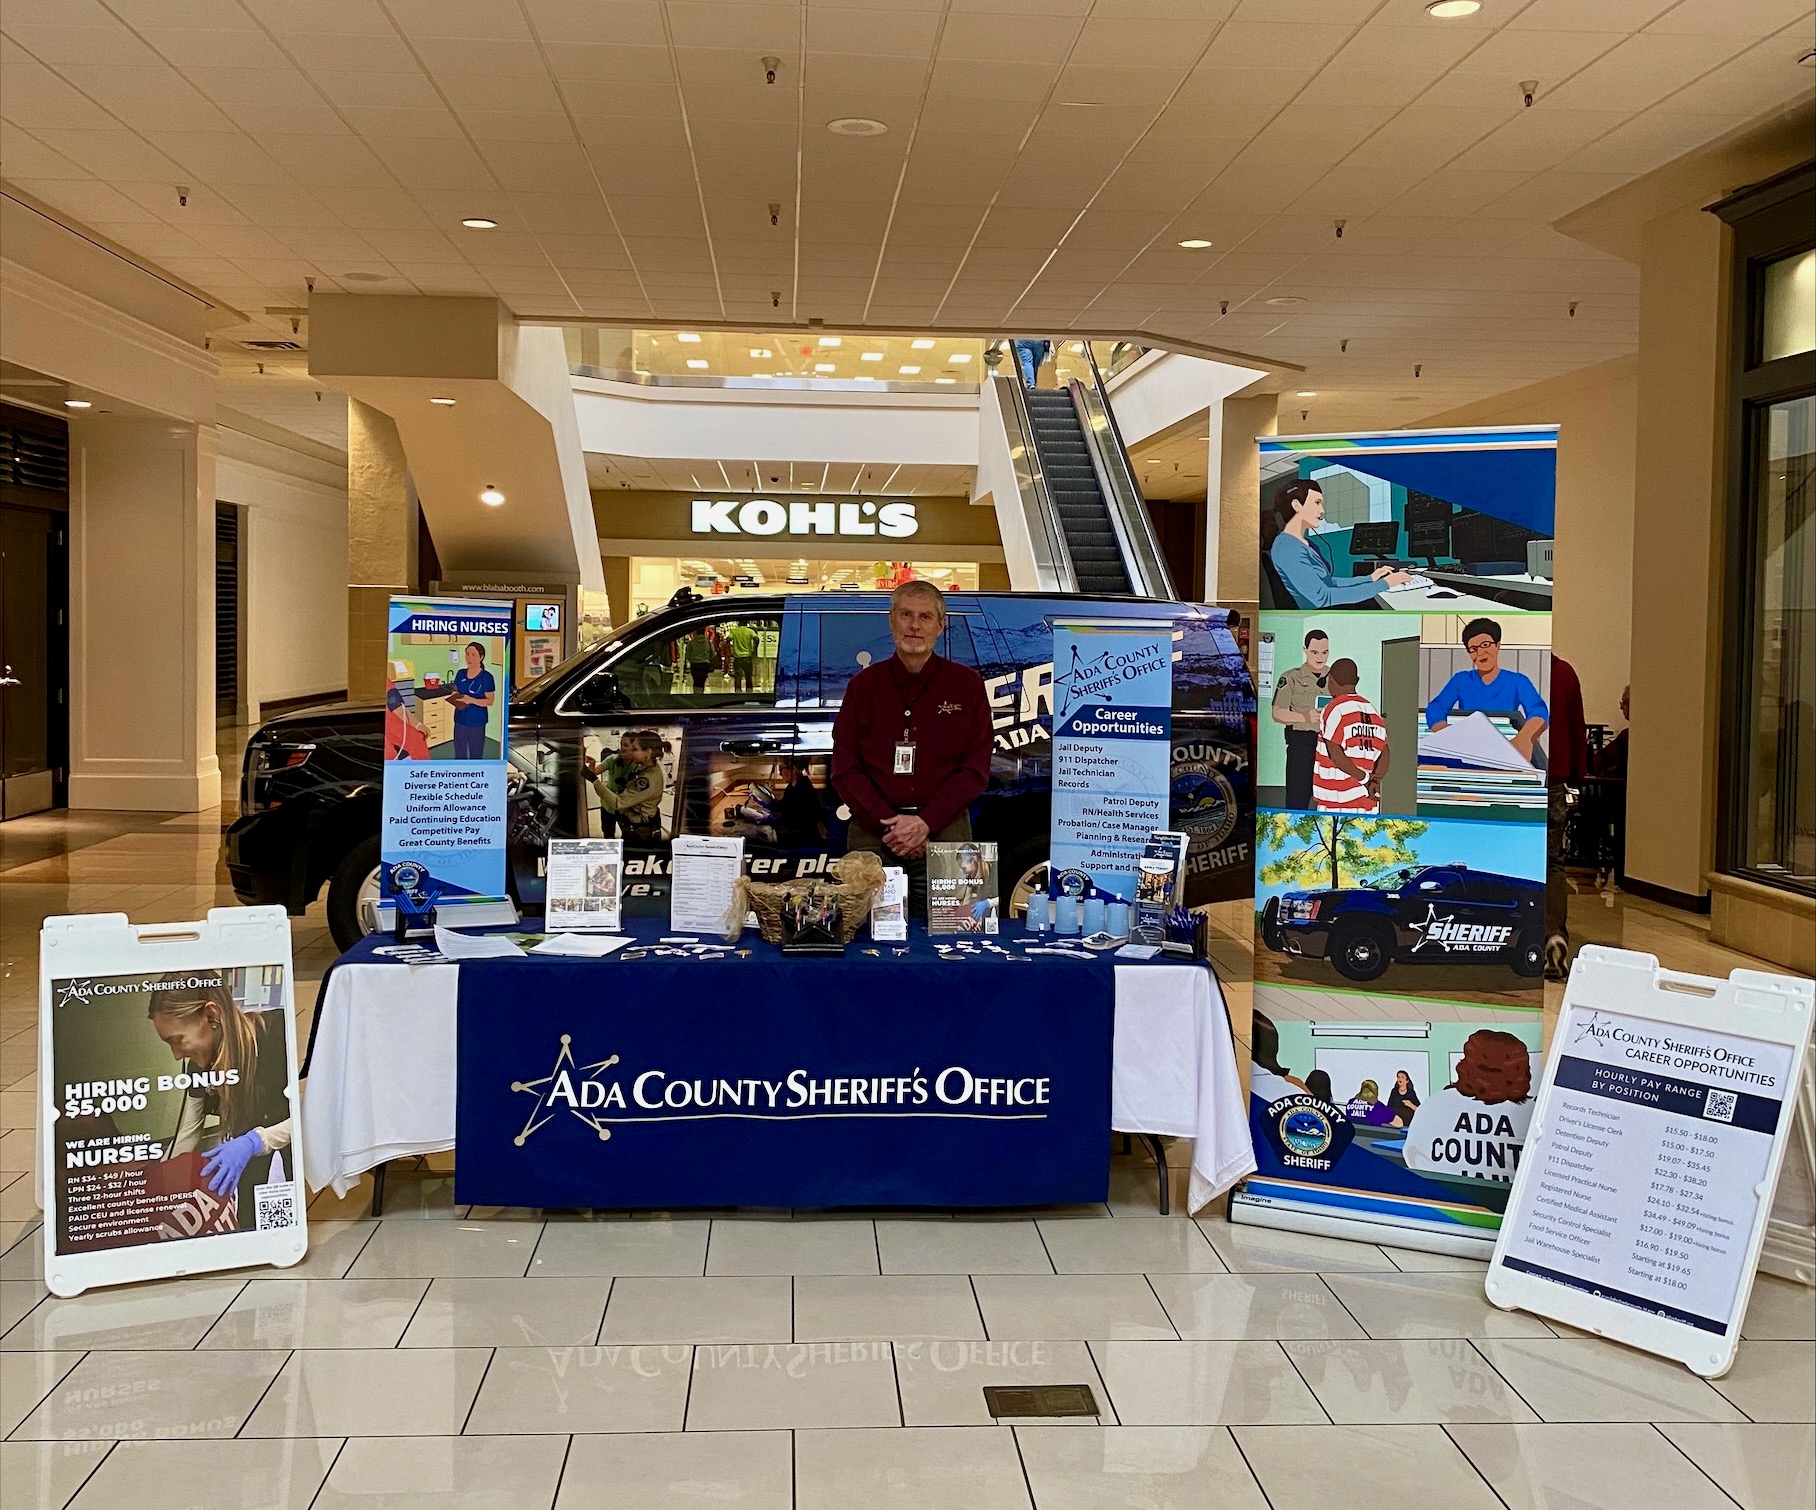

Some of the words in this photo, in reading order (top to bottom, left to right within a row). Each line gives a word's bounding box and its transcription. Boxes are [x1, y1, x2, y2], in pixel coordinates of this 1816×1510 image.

[691, 500, 918, 538] KOHL'S
[462, 584, 544, 593] www.blababooth.com
[412, 619, 457, 632] HIRING
[460, 622, 508, 633] NURSES
[1074, 665, 1102, 683] ADA
[1105, 643, 1159, 670] COUNTY
[1071, 671, 1121, 699] SHERIFF'S
[1123, 658, 1166, 679] OFFICE
[1095, 708, 1137, 720] Career
[1072, 720, 1163, 734] Opportunities
[1074, 744, 1103, 753] Deputy
[1075, 757, 1118, 766] Dispatcher
[1170, 745, 1248, 771] OUNTY
[1073, 769, 1115, 777] Technician
[1059, 780, 1089, 788] Records
[1129, 799, 1159, 808] Deputy
[410, 816, 458, 824] Continuing
[1083, 808, 1123, 817] RN/Health
[1125, 811, 1158, 819] Services
[411, 827, 462, 836] Competitive
[1123, 823, 1158, 833] Manager
[425, 838, 455, 846] County
[457, 837, 491, 845] Benefits
[1077, 832, 1111, 842] Planning
[1122, 835, 1151, 843] Resear
[1091, 850, 1144, 859] Administrati
[1187, 843, 1248, 875] HERIFF
[1080, 862, 1113, 870] Support
[1426, 922, 1512, 942] SHERIFF
[68, 986, 93, 997] ADA
[94, 983, 141, 995] COUNTY
[142, 979, 186, 992] SHERIFF'S
[188, 977, 222, 988] OFFICE
[1586, 1023, 1610, 1039] ADA
[1612, 1028, 1660, 1047] COUNTY
[1662, 1037, 1711, 1058] SHERIFF'S
[1714, 1048, 1755, 1067] OFFICE
[1626, 1048, 1670, 1066] CAREER
[1674, 1058, 1776, 1087] OPPORTUNITIES
[65, 1077, 150, 1099] HIRING
[157, 1069, 240, 1091] BONUS
[546, 1070, 626, 1108] ADA
[632, 1070, 784, 1109] COUNTY
[785, 1066, 929, 1107] SHERIFF'S
[935, 1066, 1050, 1106] OFFICE
[1595, 1068, 1638, 1084] HOURLY
[1640, 1079, 1662, 1089] PAY
[1665, 1084, 1702, 1098] RANGE
[1592, 1081, 1605, 1090] BY
[1609, 1084, 1659, 1102] POSITION
[65, 1094, 147, 1119] $5,000
[1268, 1099, 1293, 1117] ADA
[1295, 1096, 1346, 1123] COUNTY
[1562, 1102, 1586, 1113] Records
[1588, 1108, 1620, 1120] Technician
[1454, 1112, 1515, 1137] ADA
[1583, 1122, 1605, 1132] License
[1607, 1127, 1623, 1136] Clerk
[66, 1140, 85, 1149] WE
[87, 1137, 109, 1148] ARE
[113, 1134, 150, 1145] HIRING
[1555, 1129, 1585, 1140] Detention
[1587, 1136, 1609, 1147] Deputy
[1665, 1126, 1688, 1137] $15.50
[1694, 1133, 1718, 1144] $18.00
[66, 1143, 163, 1168] NURSES
[1431, 1138, 1523, 1171] COUNT
[1552, 1142, 1569, 1151] Patrol
[1571, 1147, 1593, 1158] Deputy
[1662, 1140, 1684, 1151] $15.00
[1690, 1147, 1714, 1158] $17.50
[1284, 1155, 1330, 1170] SHERIFF
[1561, 1159, 1594, 1172] Dispatcher
[1658, 1154, 1681, 1165] $19.07
[1687, 1161, 1711, 1172] $35.45
[81, 1175, 97, 1183] $34
[1544, 1169, 1570, 1180] Licensed
[1571, 1176, 1597, 1187] Practical
[1598, 1183, 1617, 1193] Nurse
[1655, 1168, 1677, 1179] $22.30
[1683, 1175, 1707, 1186] $38.20
[86, 1184, 101, 1192] $24
[93, 1192, 122, 1200] 12-hour
[1540, 1182, 1572, 1195] Registered
[1573, 1191, 1591, 1201] Nurse
[1680, 1190, 1703, 1200] $27.34
[69, 1204, 105, 1212] Excellent
[107, 1201, 133, 1209] county
[136, 1196, 168, 1204] benefits
[127, 1207, 154, 1215] license
[156, 1202, 187, 1212] renewal
[1537, 1195, 1562, 1207] Certified
[1564, 1203, 1588, 1214] Medical
[1589, 1210, 1617, 1223] Assistant
[1647, 1196, 1670, 1207] $24.10
[69, 1224, 96, 1232] Secure
[98, 1217, 149, 1228] environment
[96, 1230, 122, 1239] scrubs
[124, 1225, 163, 1235] allowance
[1532, 1210, 1557, 1222] Security
[1558, 1217, 1581, 1228] Control
[1582, 1224, 1611, 1238] Specialist
[1640, 1224, 1663, 1236] $17.00
[1529, 1222, 1544, 1232] Food
[1546, 1227, 1567, 1239] Service
[1569, 1234, 1590, 1245] Officer
[1537, 1240, 1570, 1255] Warehouse
[1572, 1250, 1600, 1264] Specialist
[1632, 1253, 1657, 1266] Starting
[1665, 1248, 1689, 1260] $19.50
[1628, 1267, 1653, 1281] Starting
[1663, 1277, 1687, 1290] $18.00
